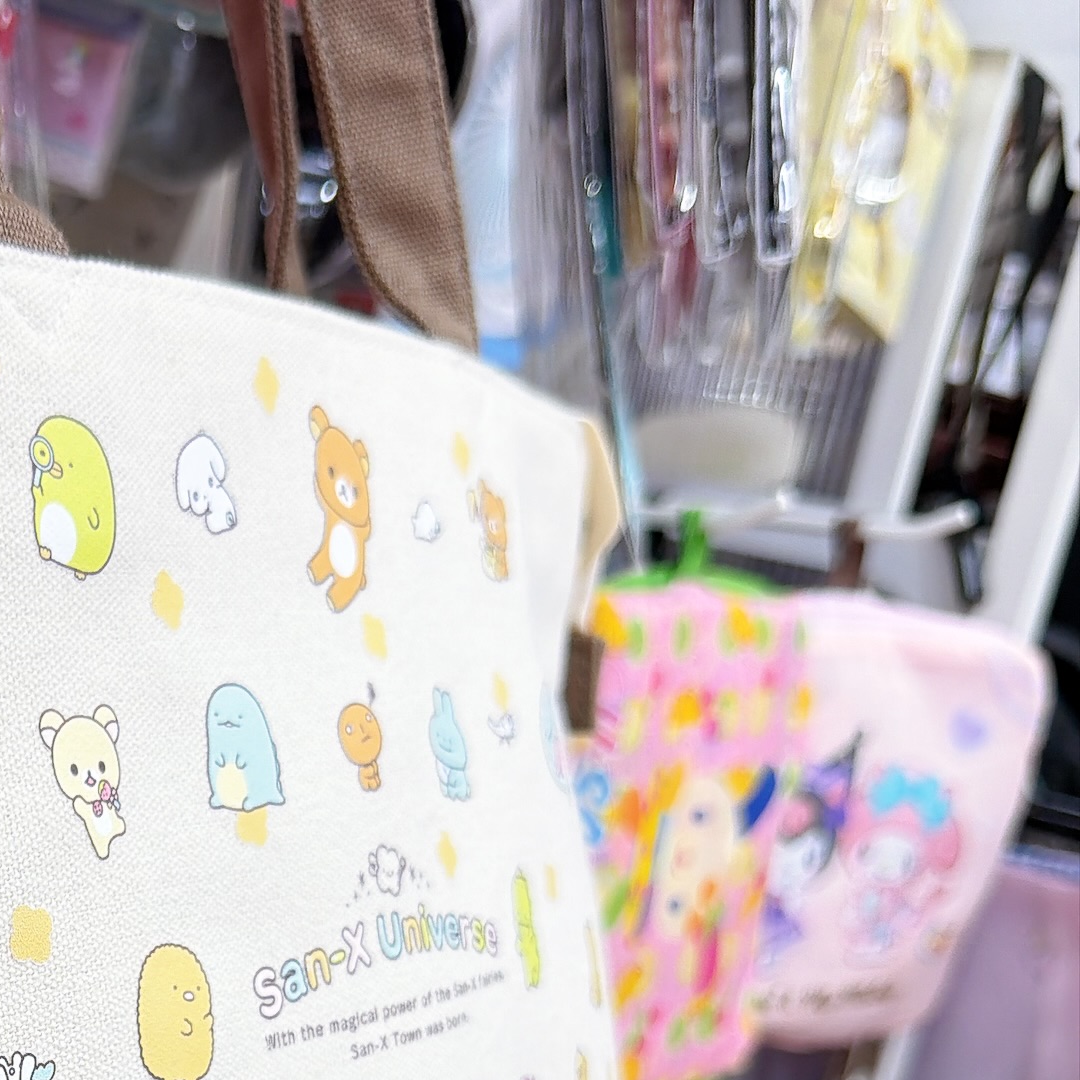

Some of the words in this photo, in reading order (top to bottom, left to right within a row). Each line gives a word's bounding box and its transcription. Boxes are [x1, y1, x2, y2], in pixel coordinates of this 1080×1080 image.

[252, 920, 372, 1020] San-X
[376, 903, 499, 961] Universe
[265, 1030, 296, 1051] With
[300, 1023, 324, 1042] the
[329, 1007, 379, 1034] magical
[383, 998, 417, 1021] power
[421, 990, 433, 1008] of
[435, 986, 451, 1003] the
[453, 977, 477, 998] San-X
[350, 1035, 389, 1060] San-X
[393, 1027, 423, 1047] Town
[425, 1021, 445, 1037] was
